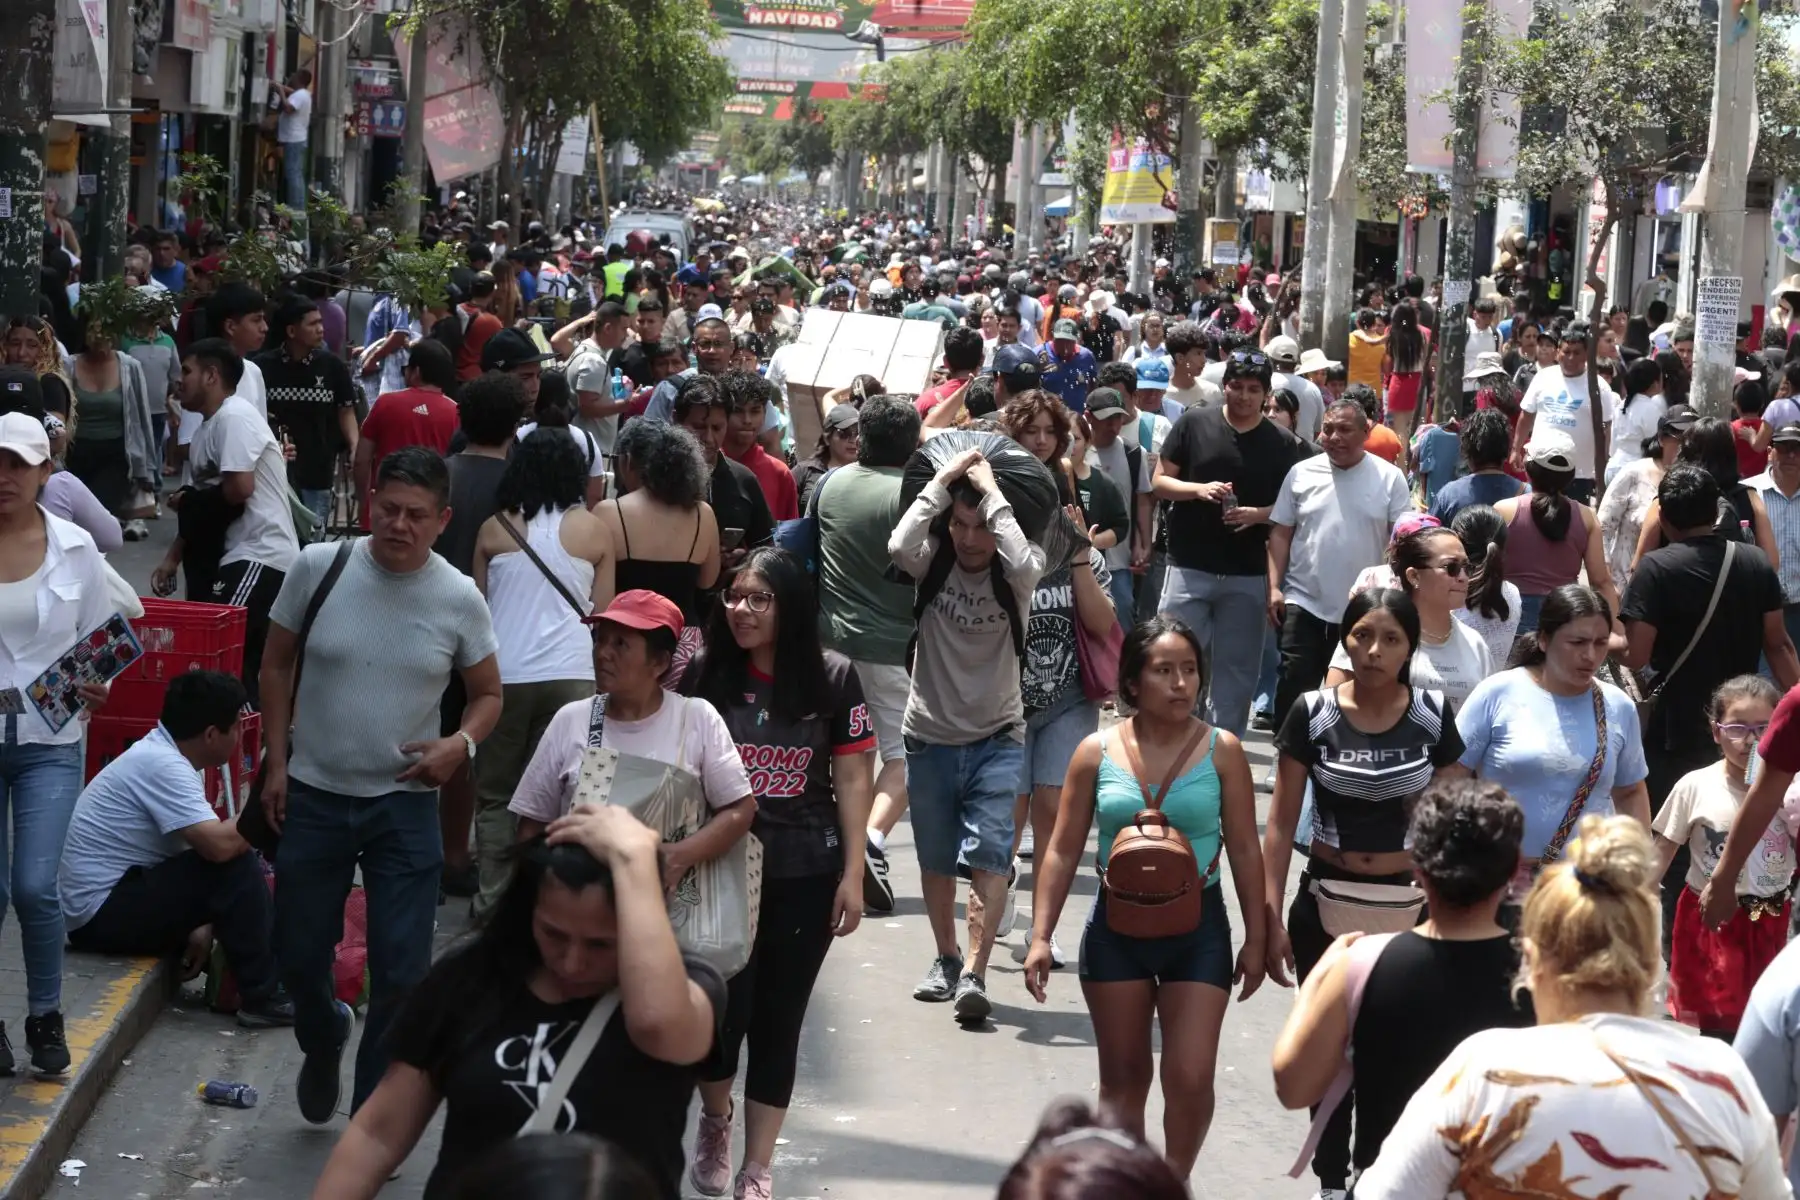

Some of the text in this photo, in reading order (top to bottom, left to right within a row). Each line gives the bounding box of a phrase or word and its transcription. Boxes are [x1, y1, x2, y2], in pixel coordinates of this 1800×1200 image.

[748, 11, 838, 28] NAVIDAD
[739, 81, 795, 94] NAVIDAD
[1699, 307, 1737, 316] URGENTE
[1338, 748, 1410, 763] DRIFT
[749, 769, 807, 797] 022
